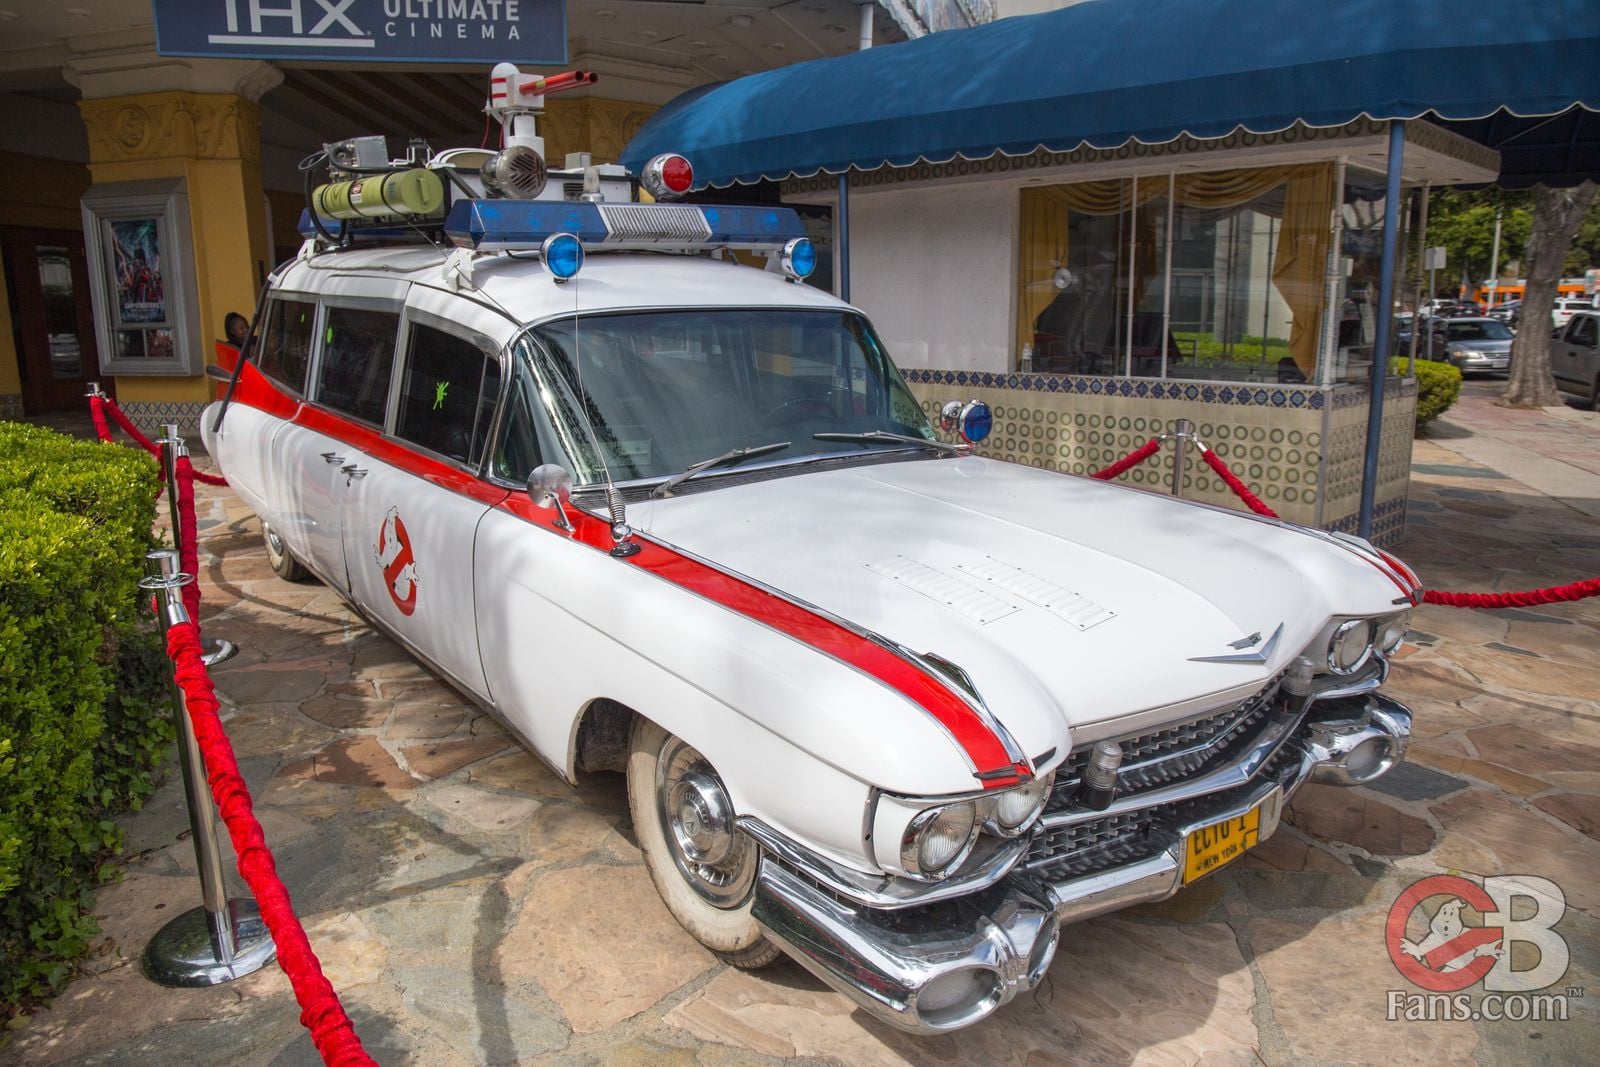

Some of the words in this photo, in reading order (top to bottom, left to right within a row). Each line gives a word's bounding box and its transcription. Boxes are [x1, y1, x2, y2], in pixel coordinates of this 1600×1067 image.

[383, 0, 521, 22] ULTIMATE
[385, 21, 520, 40] CINEMA
[1203, 855, 1219, 869] NEW
[1222, 844, 1237, 858] YORK
